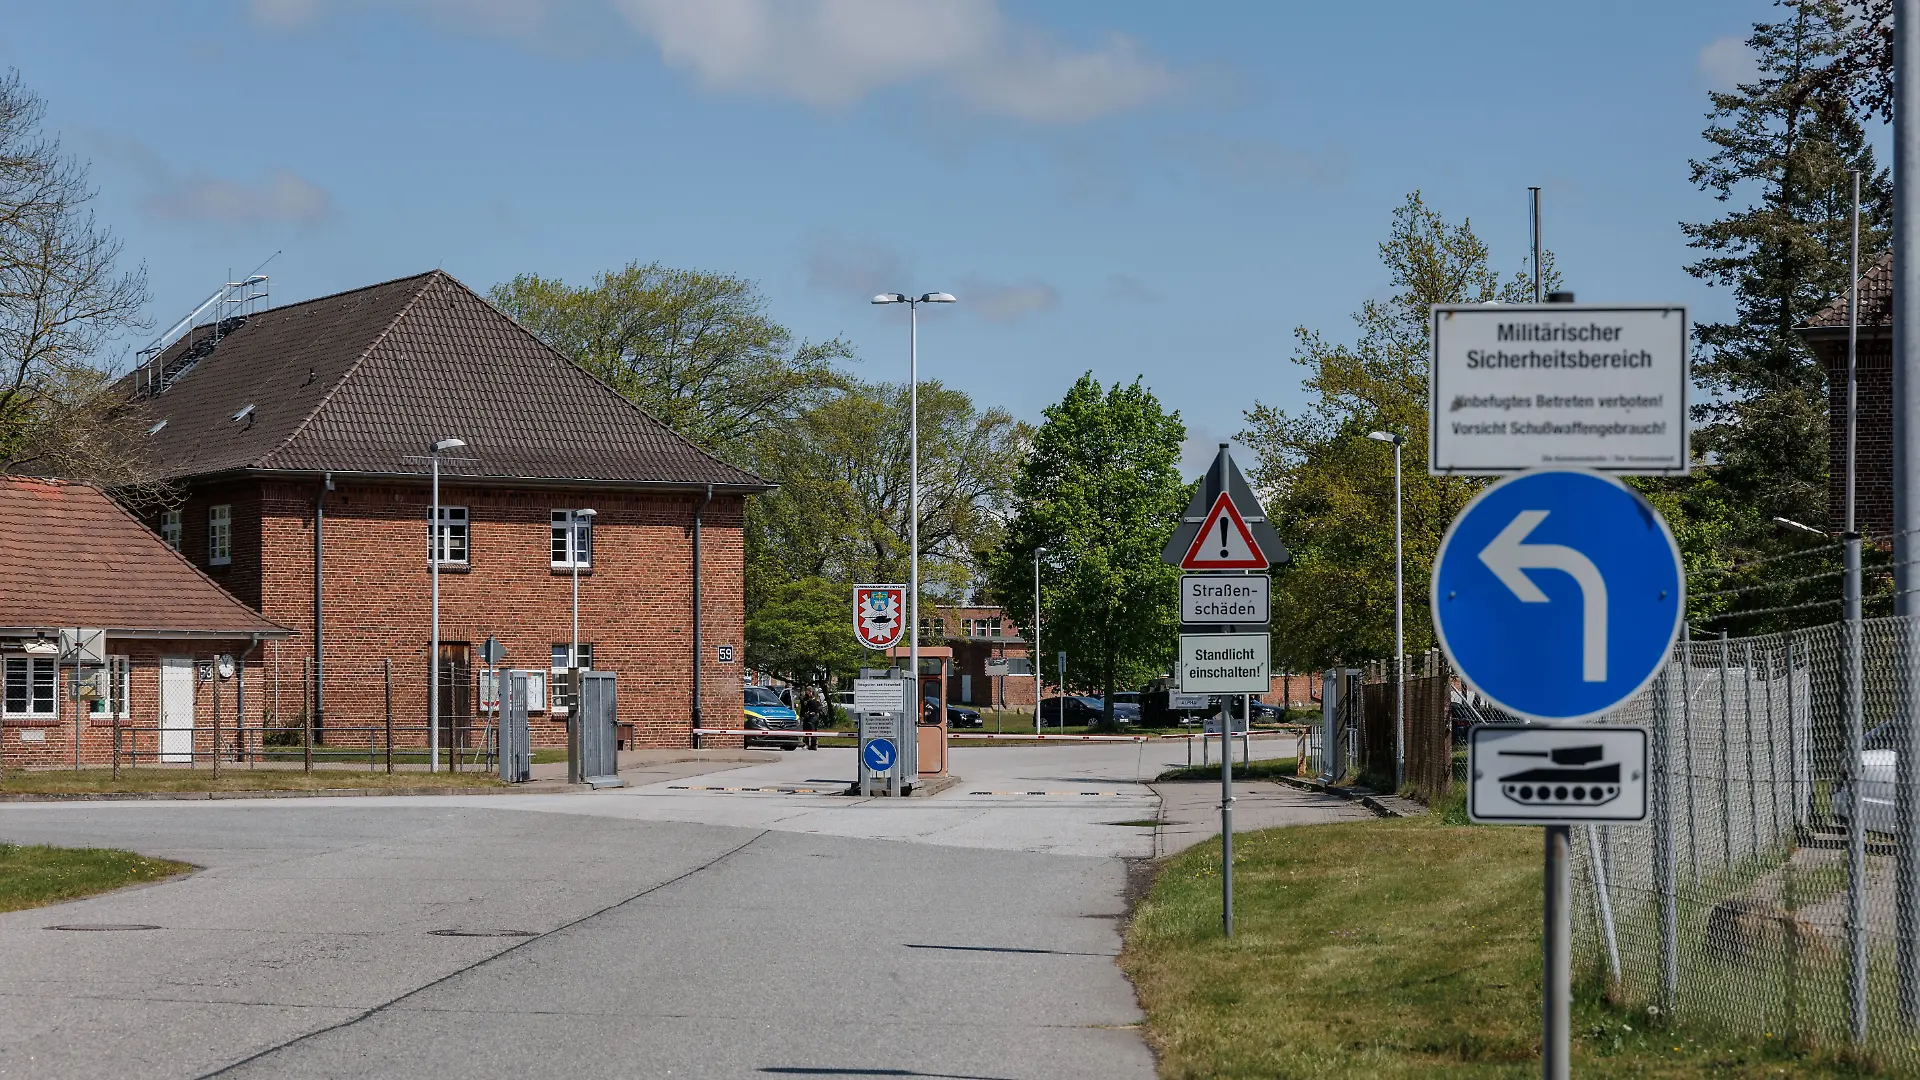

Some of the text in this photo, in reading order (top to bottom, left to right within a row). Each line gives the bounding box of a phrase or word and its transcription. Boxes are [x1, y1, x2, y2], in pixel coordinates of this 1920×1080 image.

[1497, 322, 1623, 343] Militärischer
[1466, 349, 1652, 370] Sicherheitsbereich
[1536, 394, 1595, 408] Betreten
[1598, 394, 1663, 408] verboten!
[1451, 420, 1666, 437] Vorsicht Schußwaffengebrauch!
[1192, 584, 1258, 597] Straßen-
[1194, 602, 1256, 616] schäden
[719, 648, 732, 660] 59
[1195, 648, 1255, 661] Standlicht
[1189, 666, 1260, 679] einschalten!
